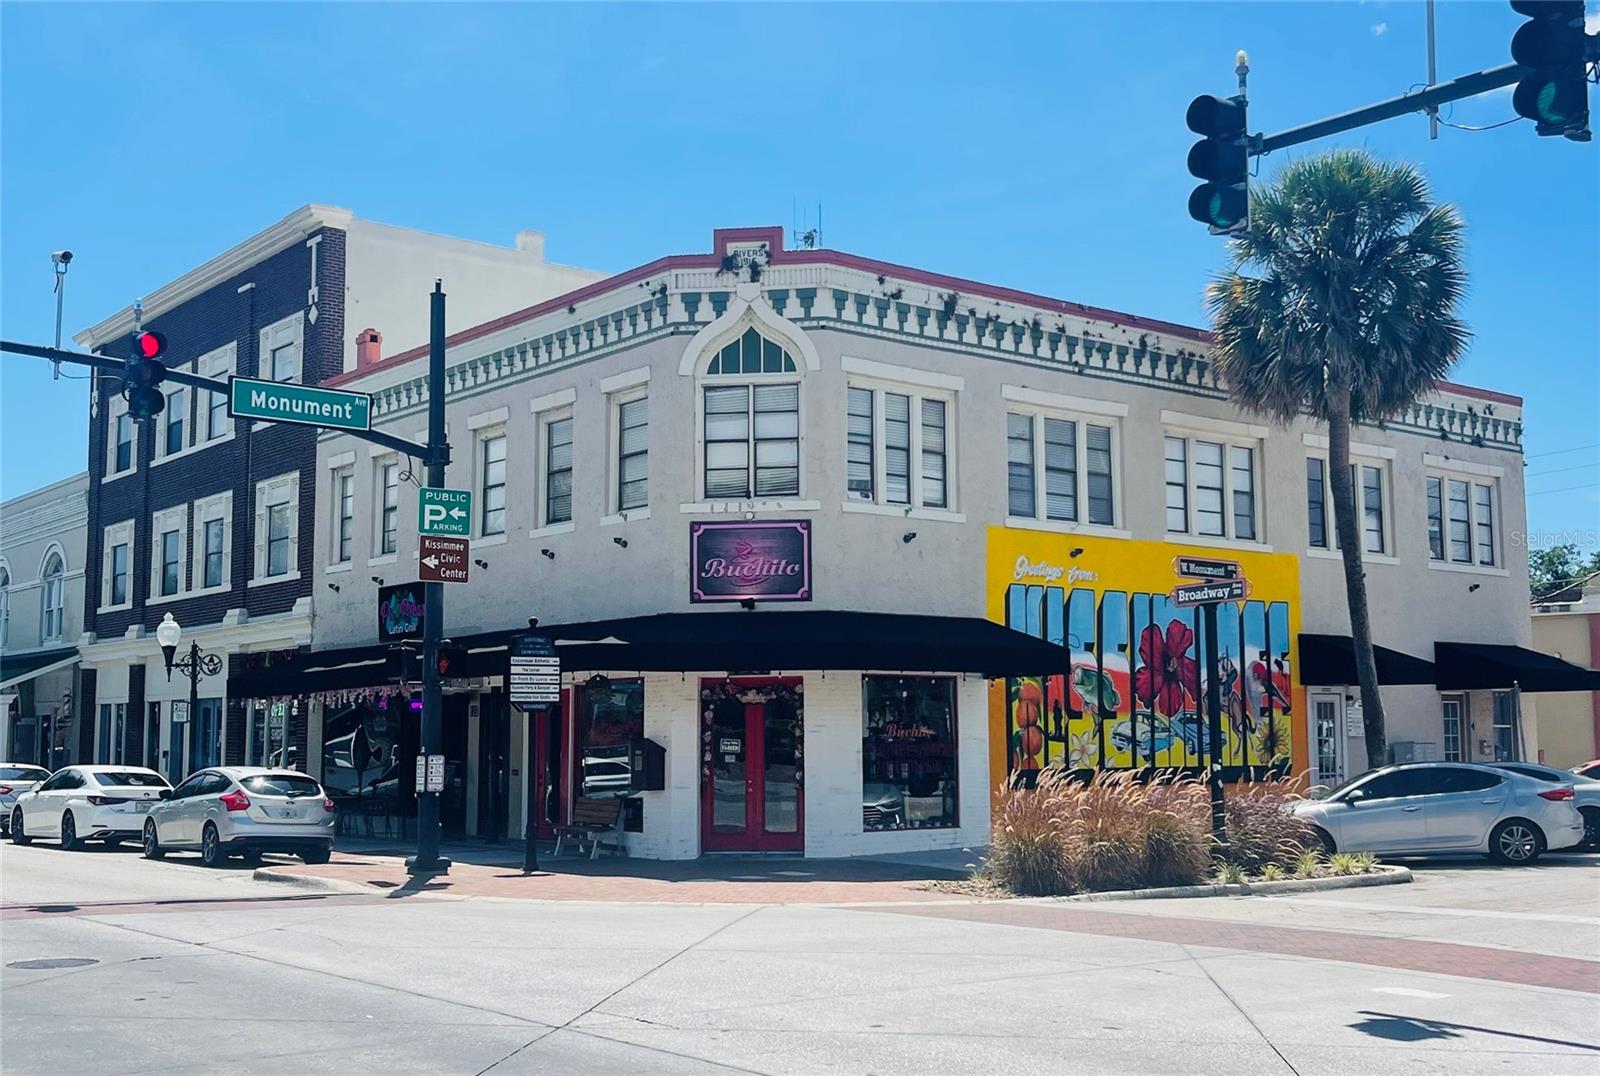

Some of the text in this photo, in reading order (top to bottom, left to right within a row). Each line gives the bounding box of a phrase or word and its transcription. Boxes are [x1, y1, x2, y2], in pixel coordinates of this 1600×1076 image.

[733, 249, 764, 257] RIVERS
[251, 390, 367, 419] Monument Ave
[425, 491, 467, 502] PUBLIC
[425, 540, 465, 551] Kissimmee
[440, 553, 461, 563] Civic
[440, 567, 467, 578] Center
[701, 557, 800, 578] Buchito
[1015, 555, 1063, 580] Greetings
[1189, 563, 1225, 576] Monument
[1178, 587, 1230, 602] Broadway
